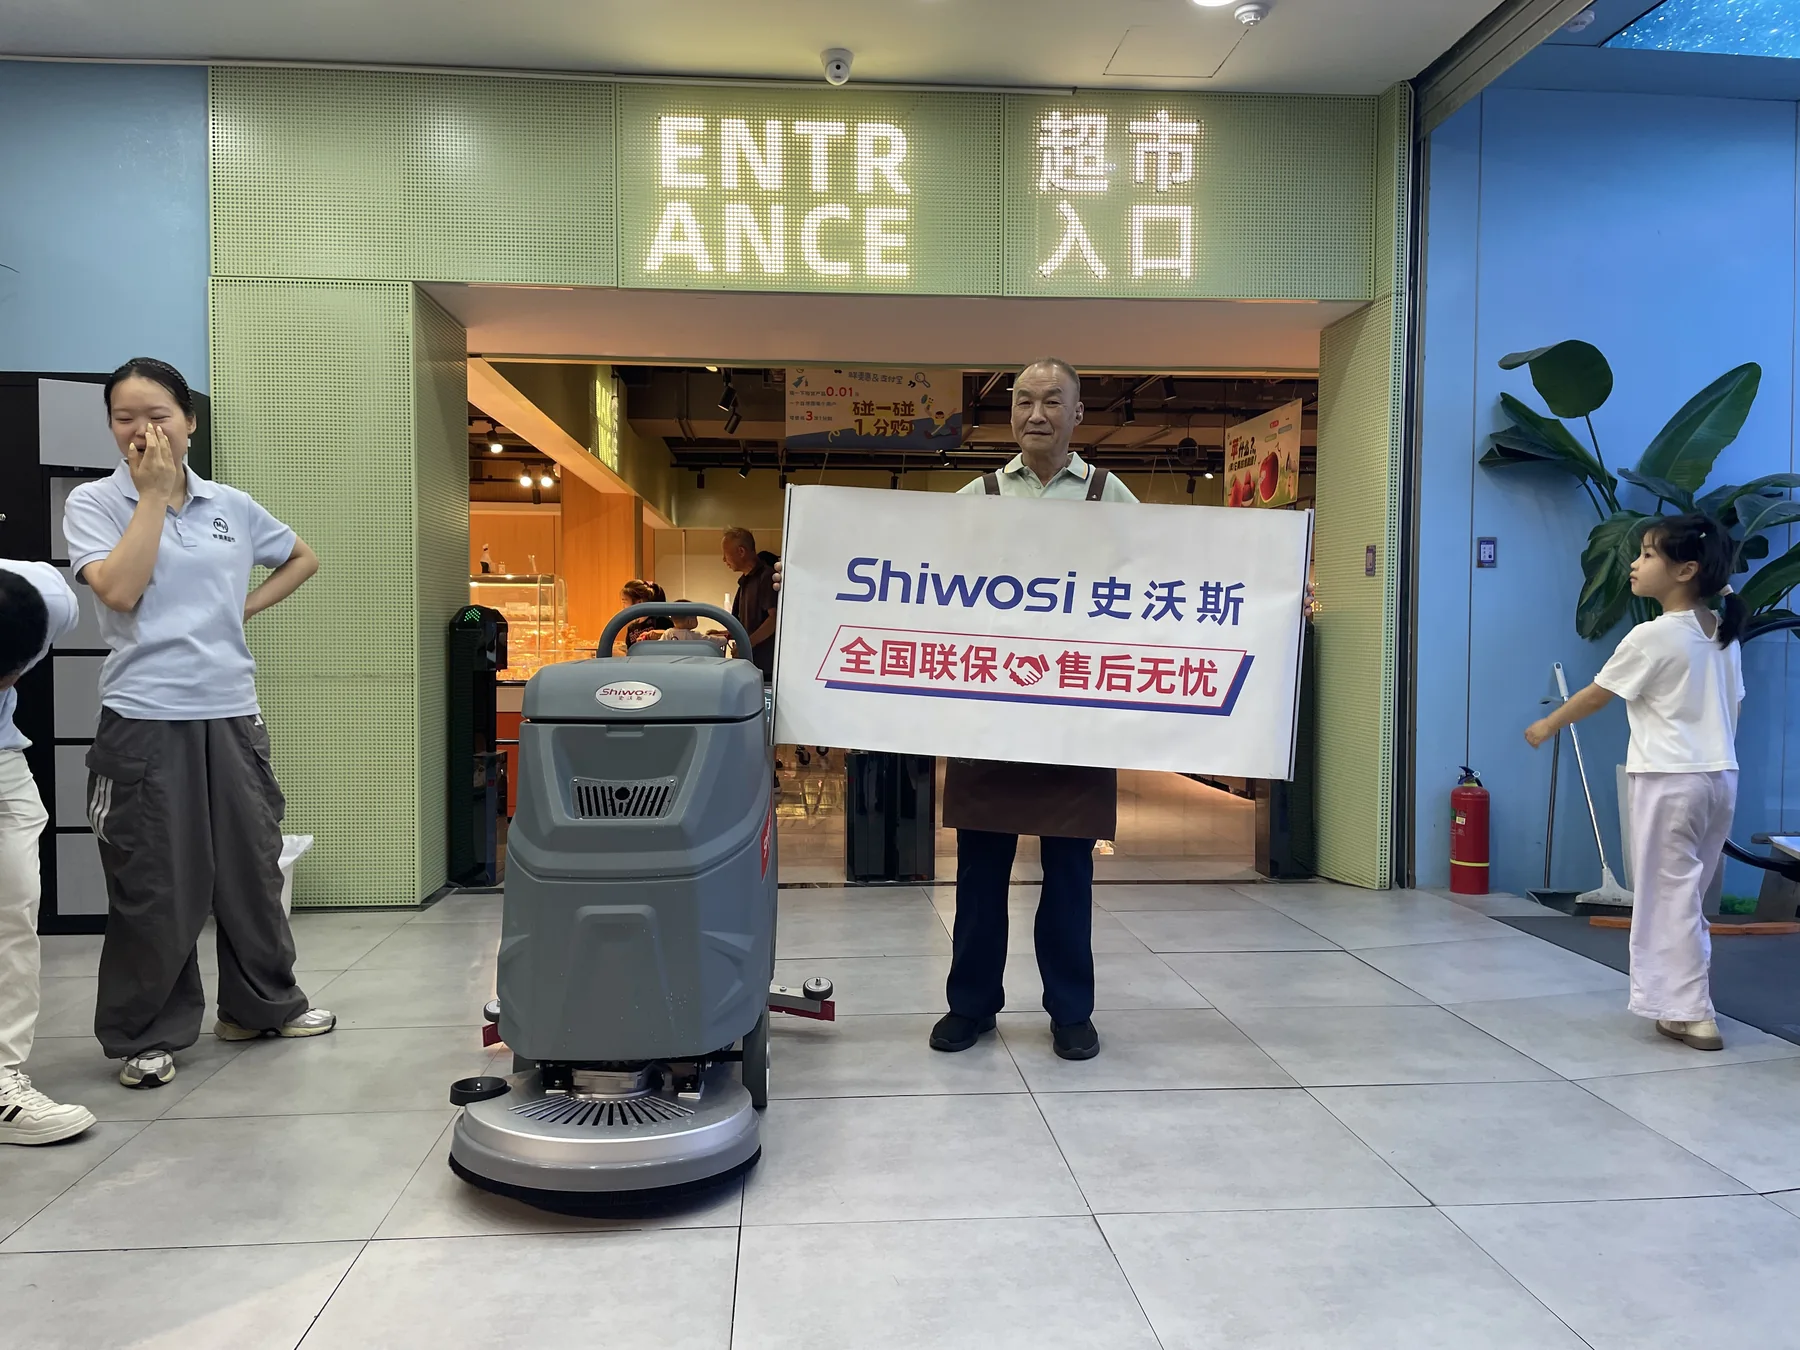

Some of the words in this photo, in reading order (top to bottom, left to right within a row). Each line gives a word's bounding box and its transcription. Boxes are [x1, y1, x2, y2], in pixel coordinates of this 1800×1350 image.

[659, 115, 911, 195] ENTR
[1037, 109, 1201, 193] 超市
[643, 200, 911, 279] ANCE
[1037, 200, 1193, 281] 入口
[852, 400, 916, 417] 碰一碰
[854, 418, 914, 436] 1分购
[835, 556, 1077, 614] Shiwosi
[1087, 576, 1246, 626] 史沃斯
[839, 636, 999, 685] 全国联保
[1055, 649, 1219, 698] 售后无忧
